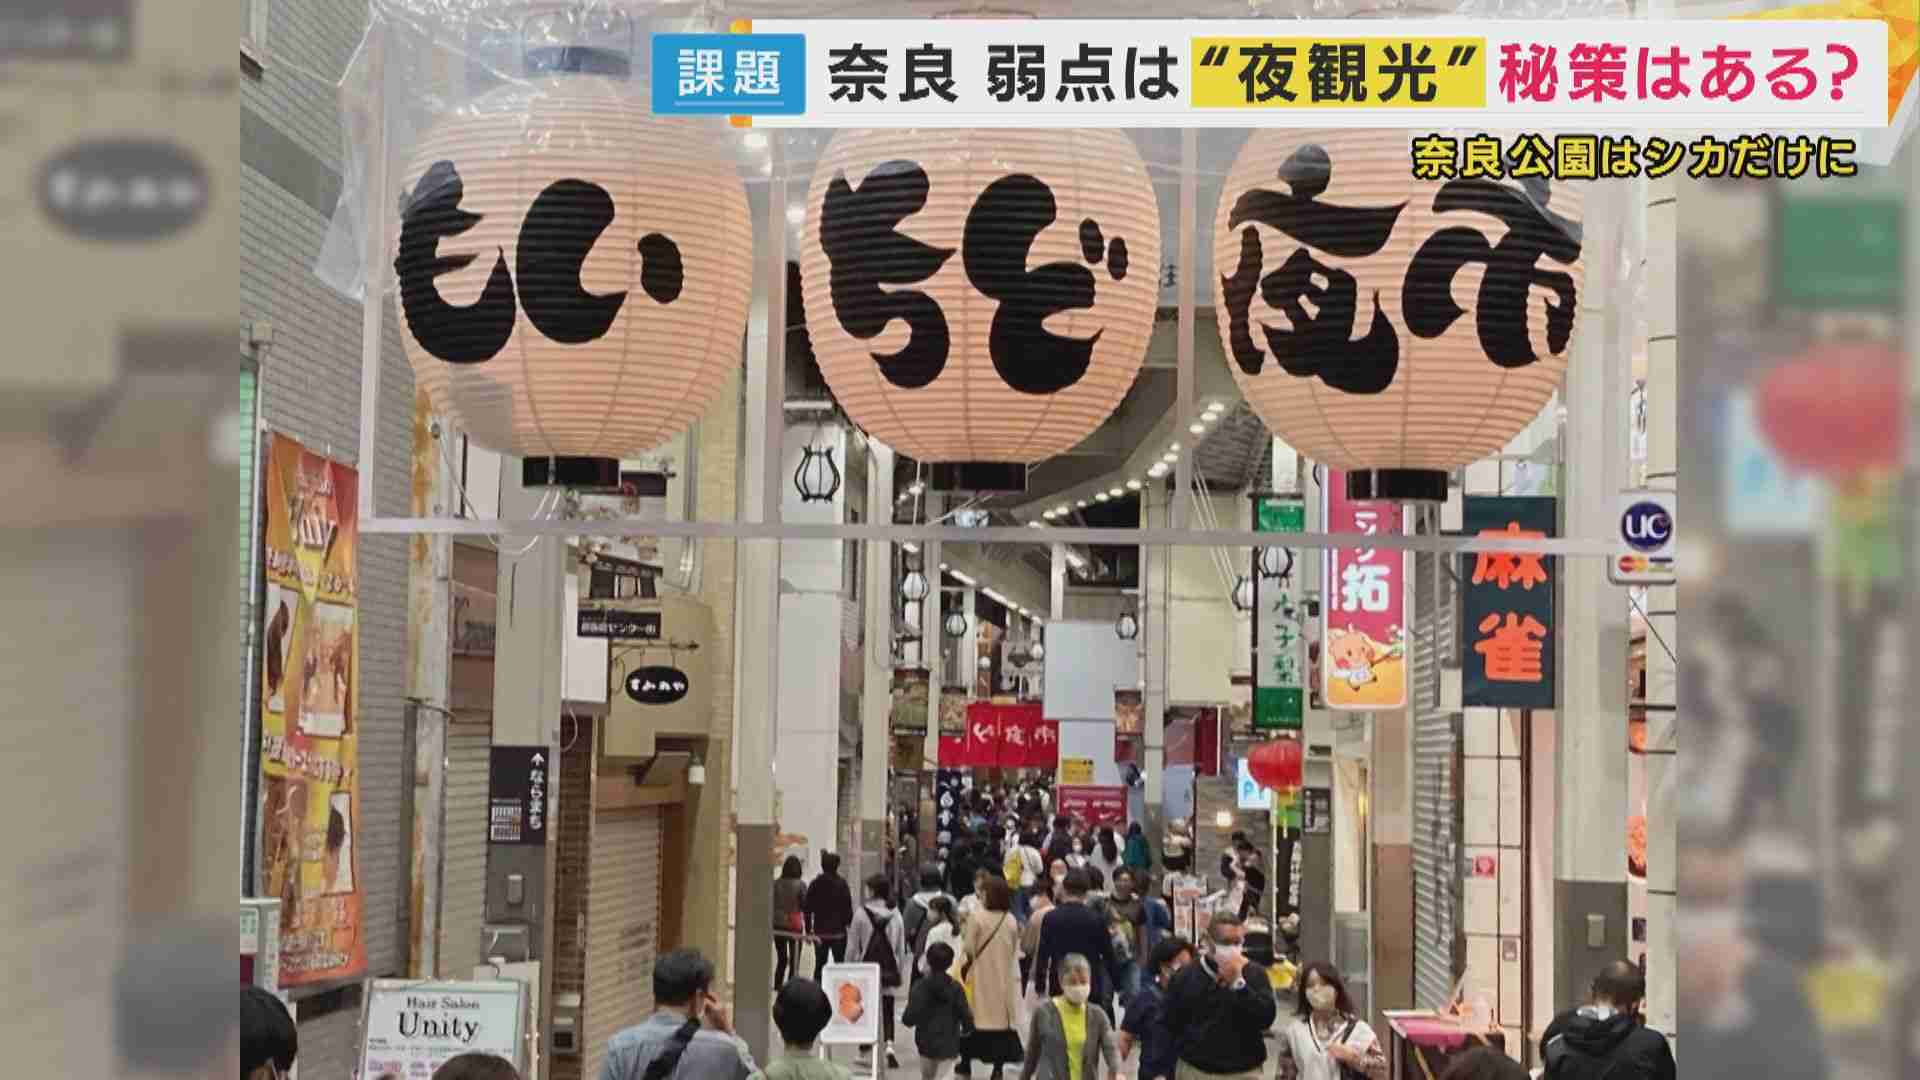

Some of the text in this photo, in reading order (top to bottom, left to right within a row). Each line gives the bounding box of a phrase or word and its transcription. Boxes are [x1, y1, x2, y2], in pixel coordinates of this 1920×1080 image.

[1625, 513, 1668, 538] UC
[1472, 521, 1547, 682] 麻雀
[530, 769, 544, 830] ならまち
[407, 997, 480, 1009] Hair Salon
[399, 1011, 479, 1044] Unity
